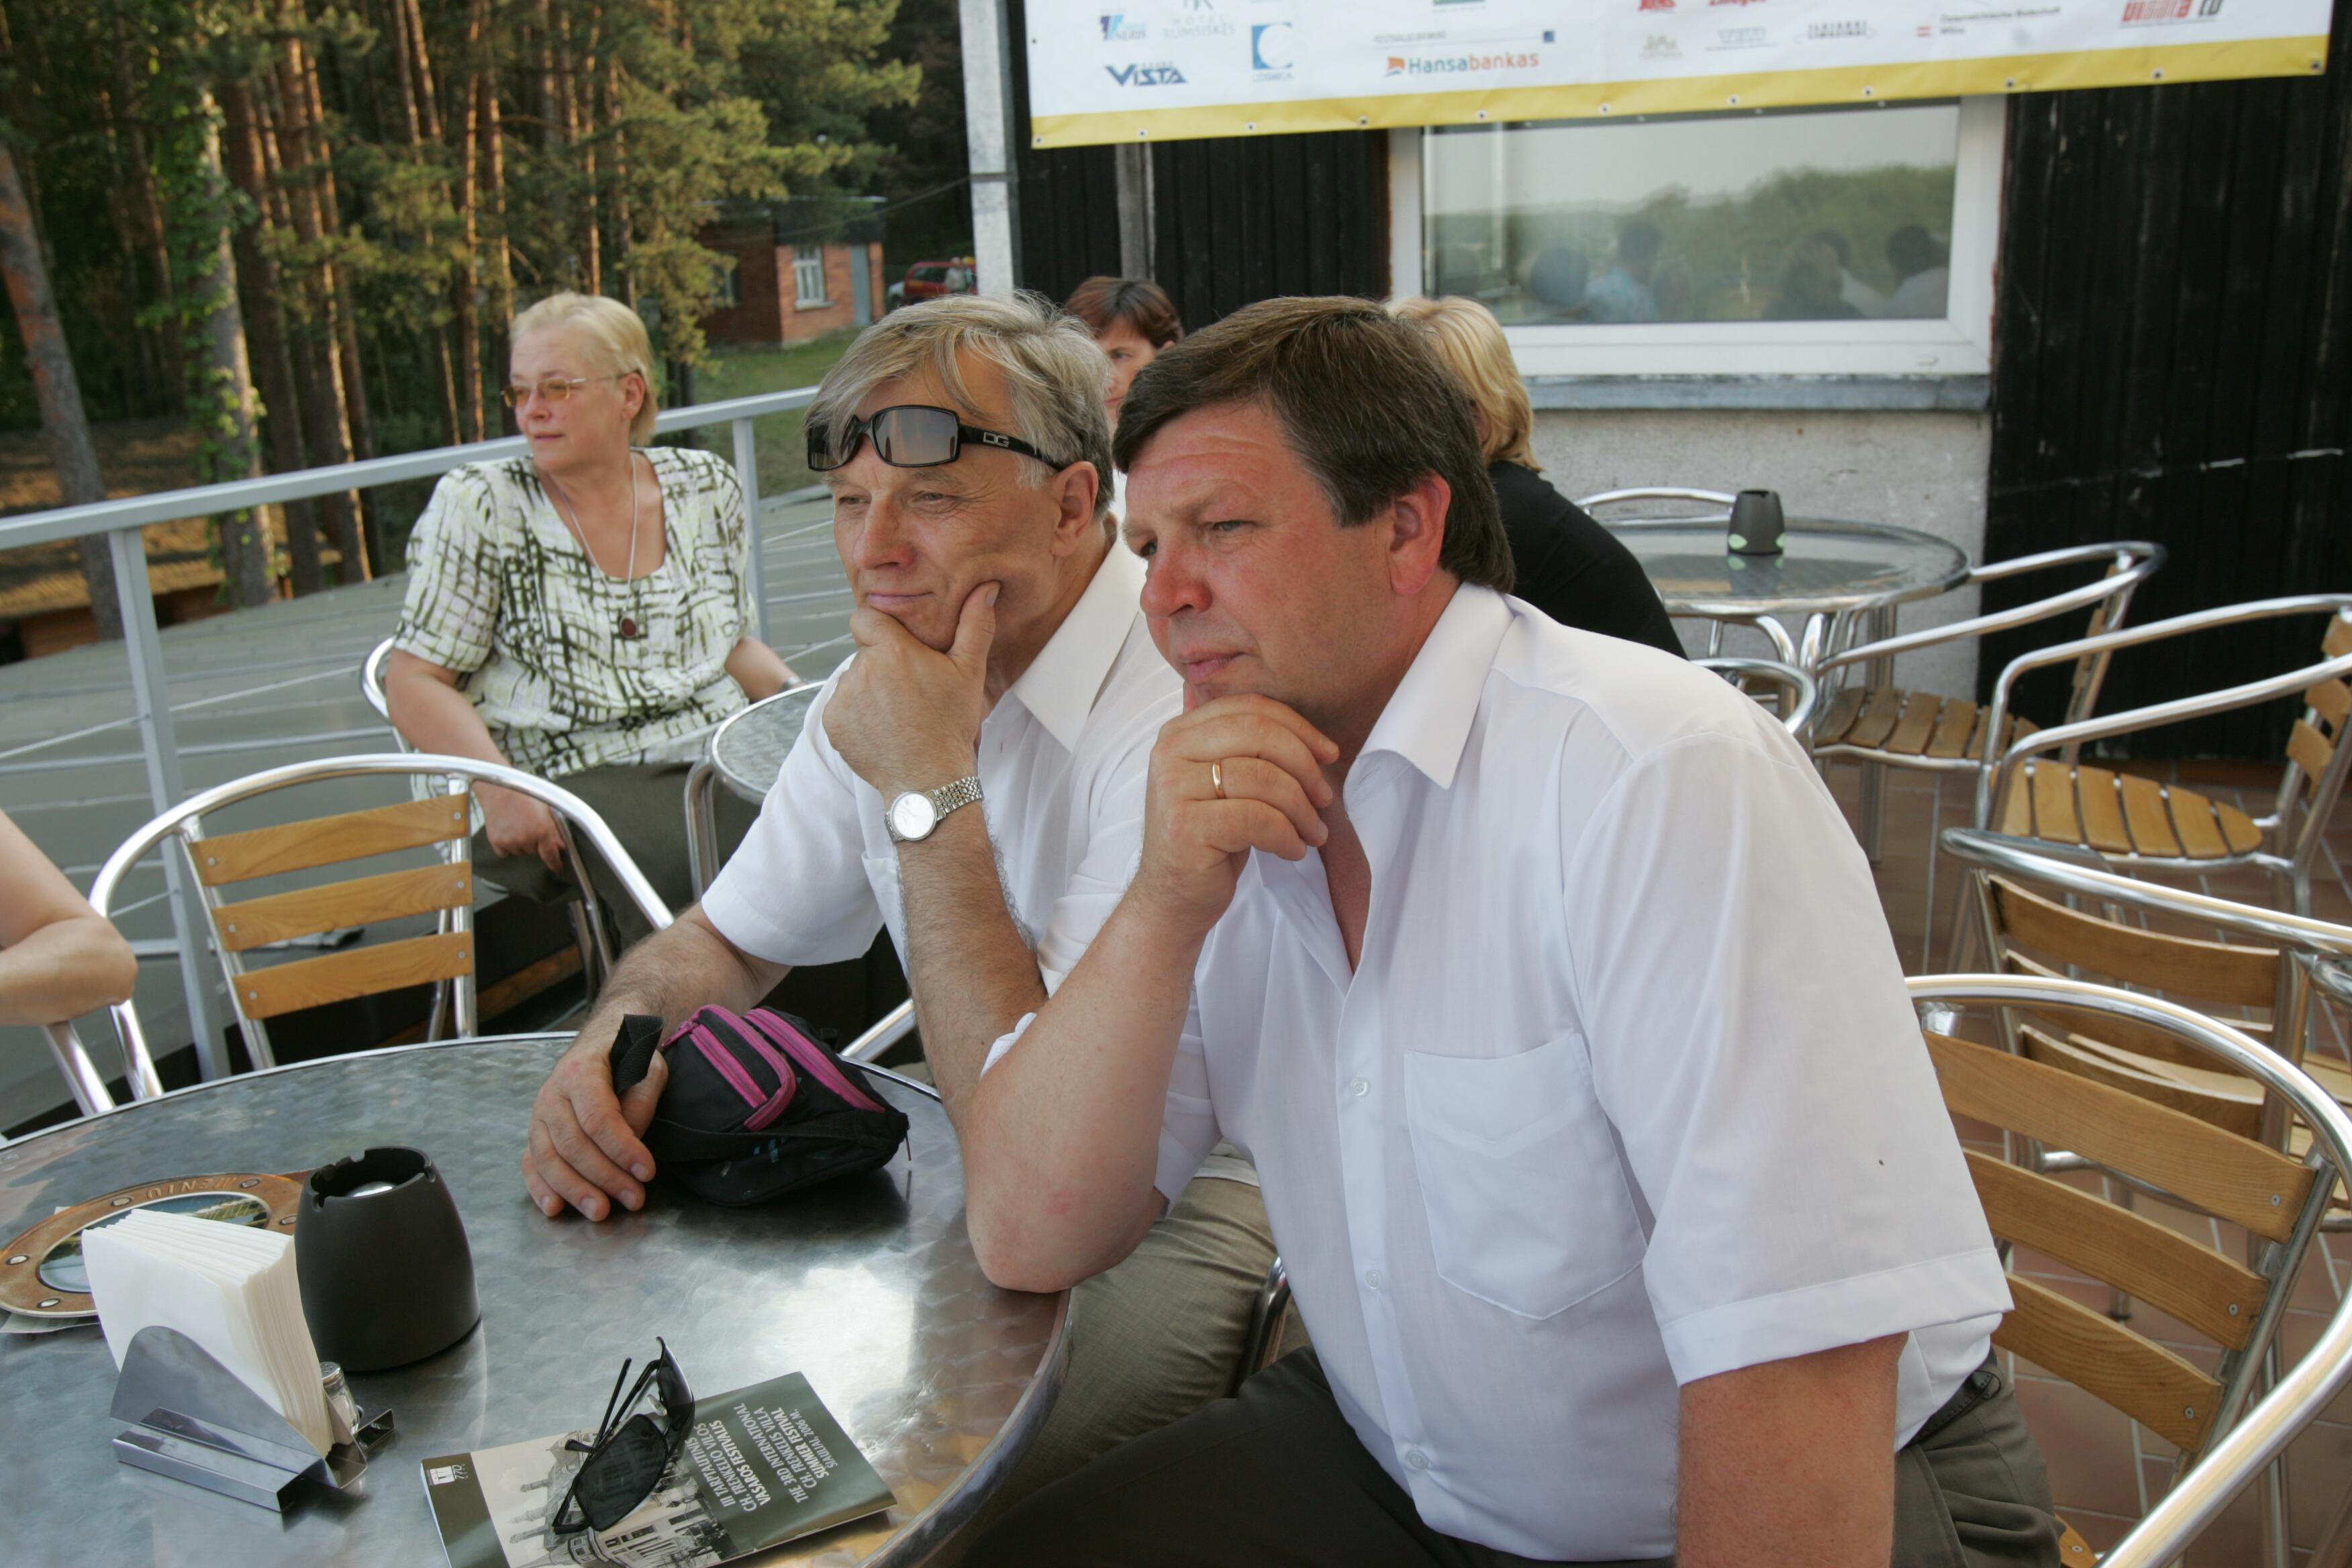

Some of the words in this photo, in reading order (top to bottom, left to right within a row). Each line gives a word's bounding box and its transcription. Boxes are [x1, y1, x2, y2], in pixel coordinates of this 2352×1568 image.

[1104, 64, 1188, 86] VISTA
[1408, 52, 1539, 75] Hansabankas
[693, 1422, 717, 1449] VILOS
[734, 1402, 783, 1467] INTERNATIONAL
[753, 1406, 777, 1432] VILLA
[771, 1407, 803, 1443] FESTIVAL
[794, 1419, 814, 1436] 2006
[709, 1419, 745, 1465] FESTIVALIS
[769, 1430, 805, 1473] FRENKELIS
[686, 1436, 728, 1496] TARPTAUTINIS
[709, 1449, 746, 1495] FRENKELIO
[776, 1467, 797, 1485] 3RD
[794, 1442, 829, 1479] SUMMER
[738, 1464, 771, 1505] VASAROS
[788, 1485, 809, 1502] THE
